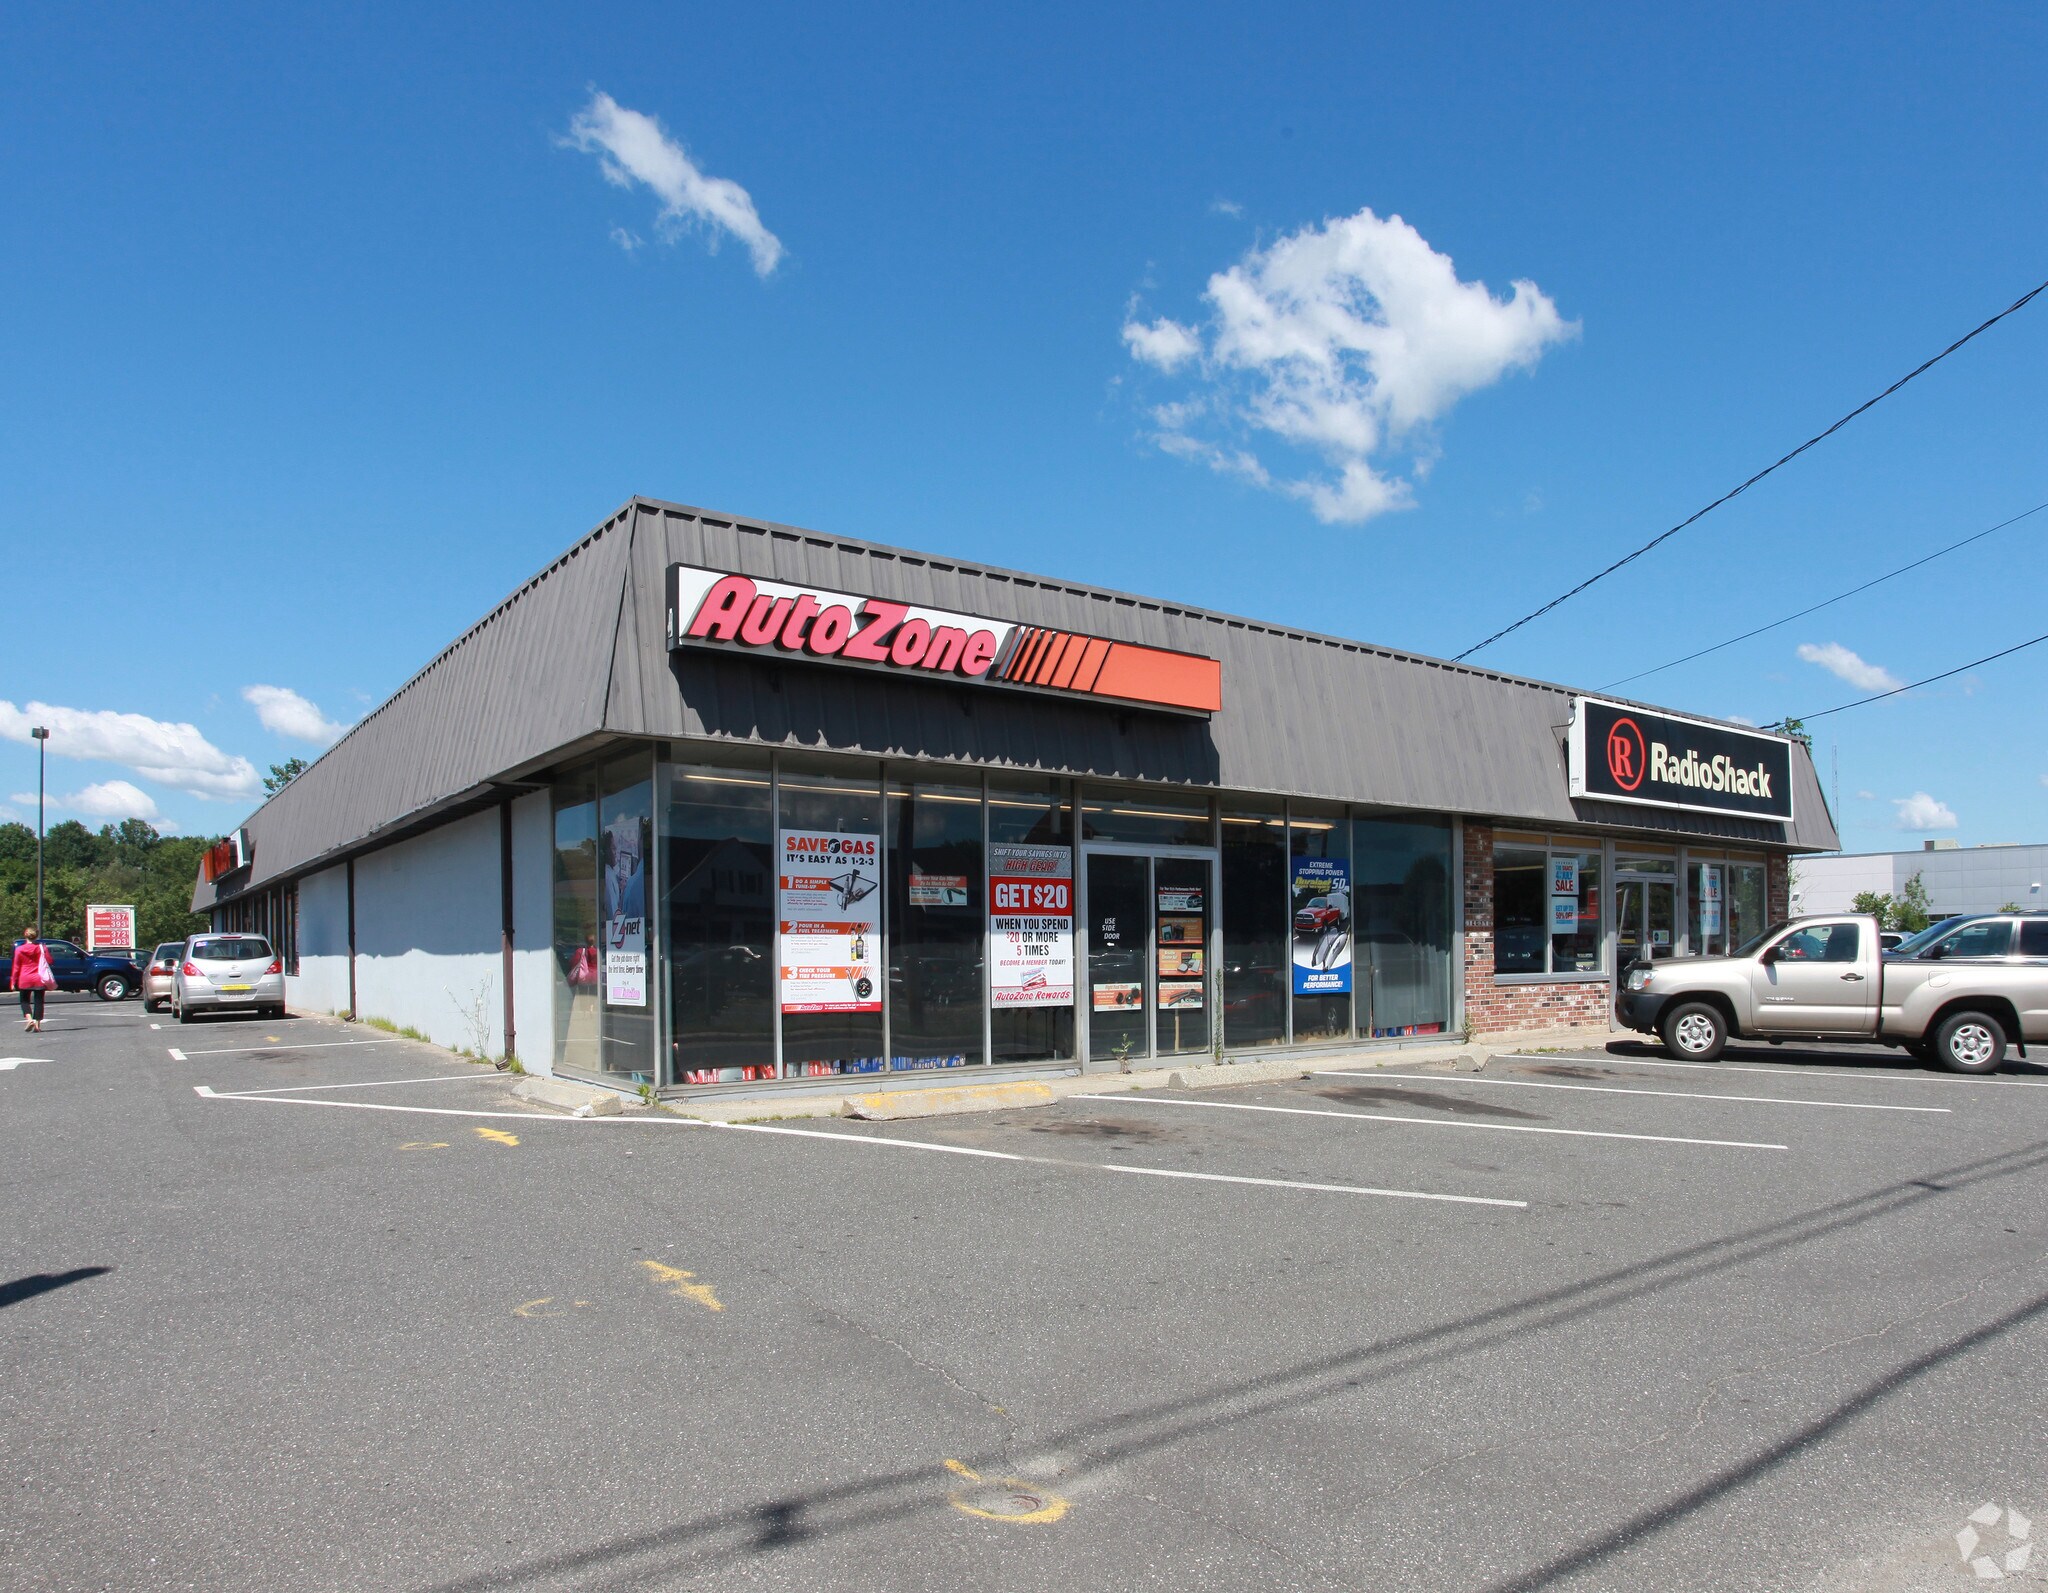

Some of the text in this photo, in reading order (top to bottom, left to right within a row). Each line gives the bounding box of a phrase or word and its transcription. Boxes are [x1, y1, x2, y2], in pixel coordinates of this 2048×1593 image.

[688, 574, 998, 677] AutoZone
[1650, 742, 1773, 799] RadioShack
[786, 836, 875, 855] SAVE GAS
[786, 853, 805, 862] IT'S
[808, 854, 832, 863] EASY
[835, 856, 848, 865] AS
[993, 848, 1067, 859] SHIFT YOUR SAVINGS INTO
[1004, 858, 1058, 872] HIGH GEAR!
[1298, 867, 1325, 875] STOPPING
[787, 875, 795, 889] 1
[1555, 880, 1574, 891] SALE
[995, 883, 1068, 908] GET $20
[786, 920, 798, 934] 2
[996, 918, 1069, 930] WHEN YOU SPEND
[1006, 931, 1059, 943] $20 OR MORE
[1016, 944, 1049, 956] 5 TIMES
[625, 965, 635, 976] Every
[786, 966, 798, 979] 3
[1307, 974, 1319, 982] FOR
[1303, 981, 1344, 989] PERFORMANCE!
[995, 990, 1071, 1001] AutoZone Rewards
